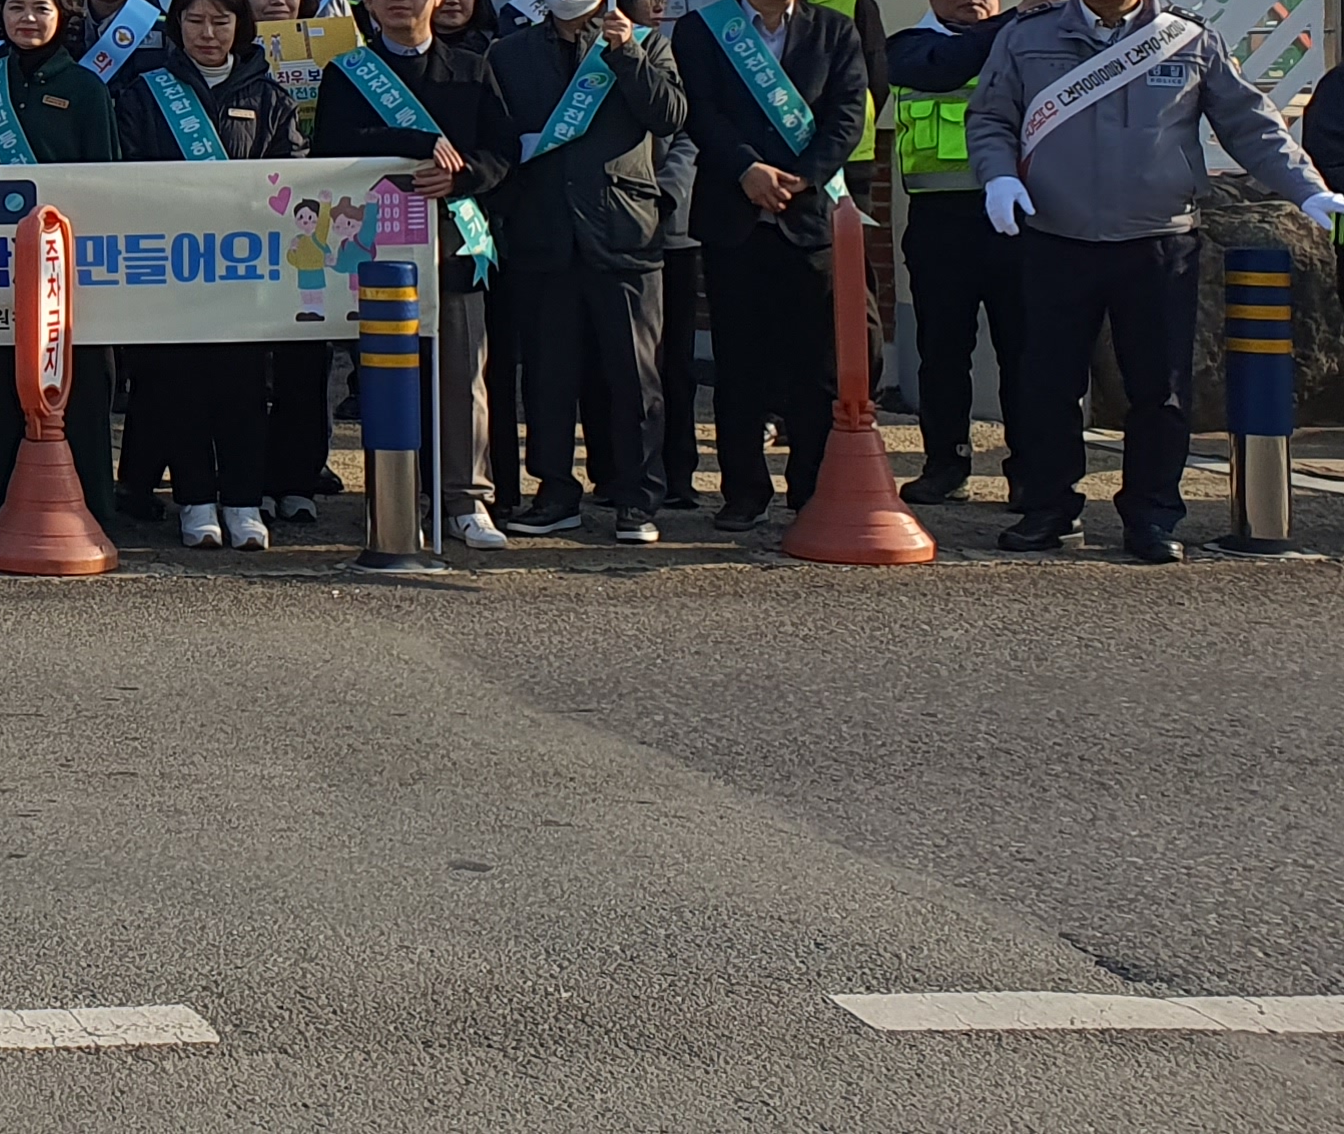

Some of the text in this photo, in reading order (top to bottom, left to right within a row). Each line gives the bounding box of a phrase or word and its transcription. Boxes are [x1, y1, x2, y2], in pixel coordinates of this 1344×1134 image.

[276, 67, 323, 85] 좌우 보
[355, 61, 404, 109] 안전한
[732, 37, 778, 88] 안전한
[154, 74, 216, 161] 안전한 등·하
[553, 91, 594, 141] 안전한
[74, 230, 282, 287] 만들어요!
[43, 237, 62, 377] 주차금지
